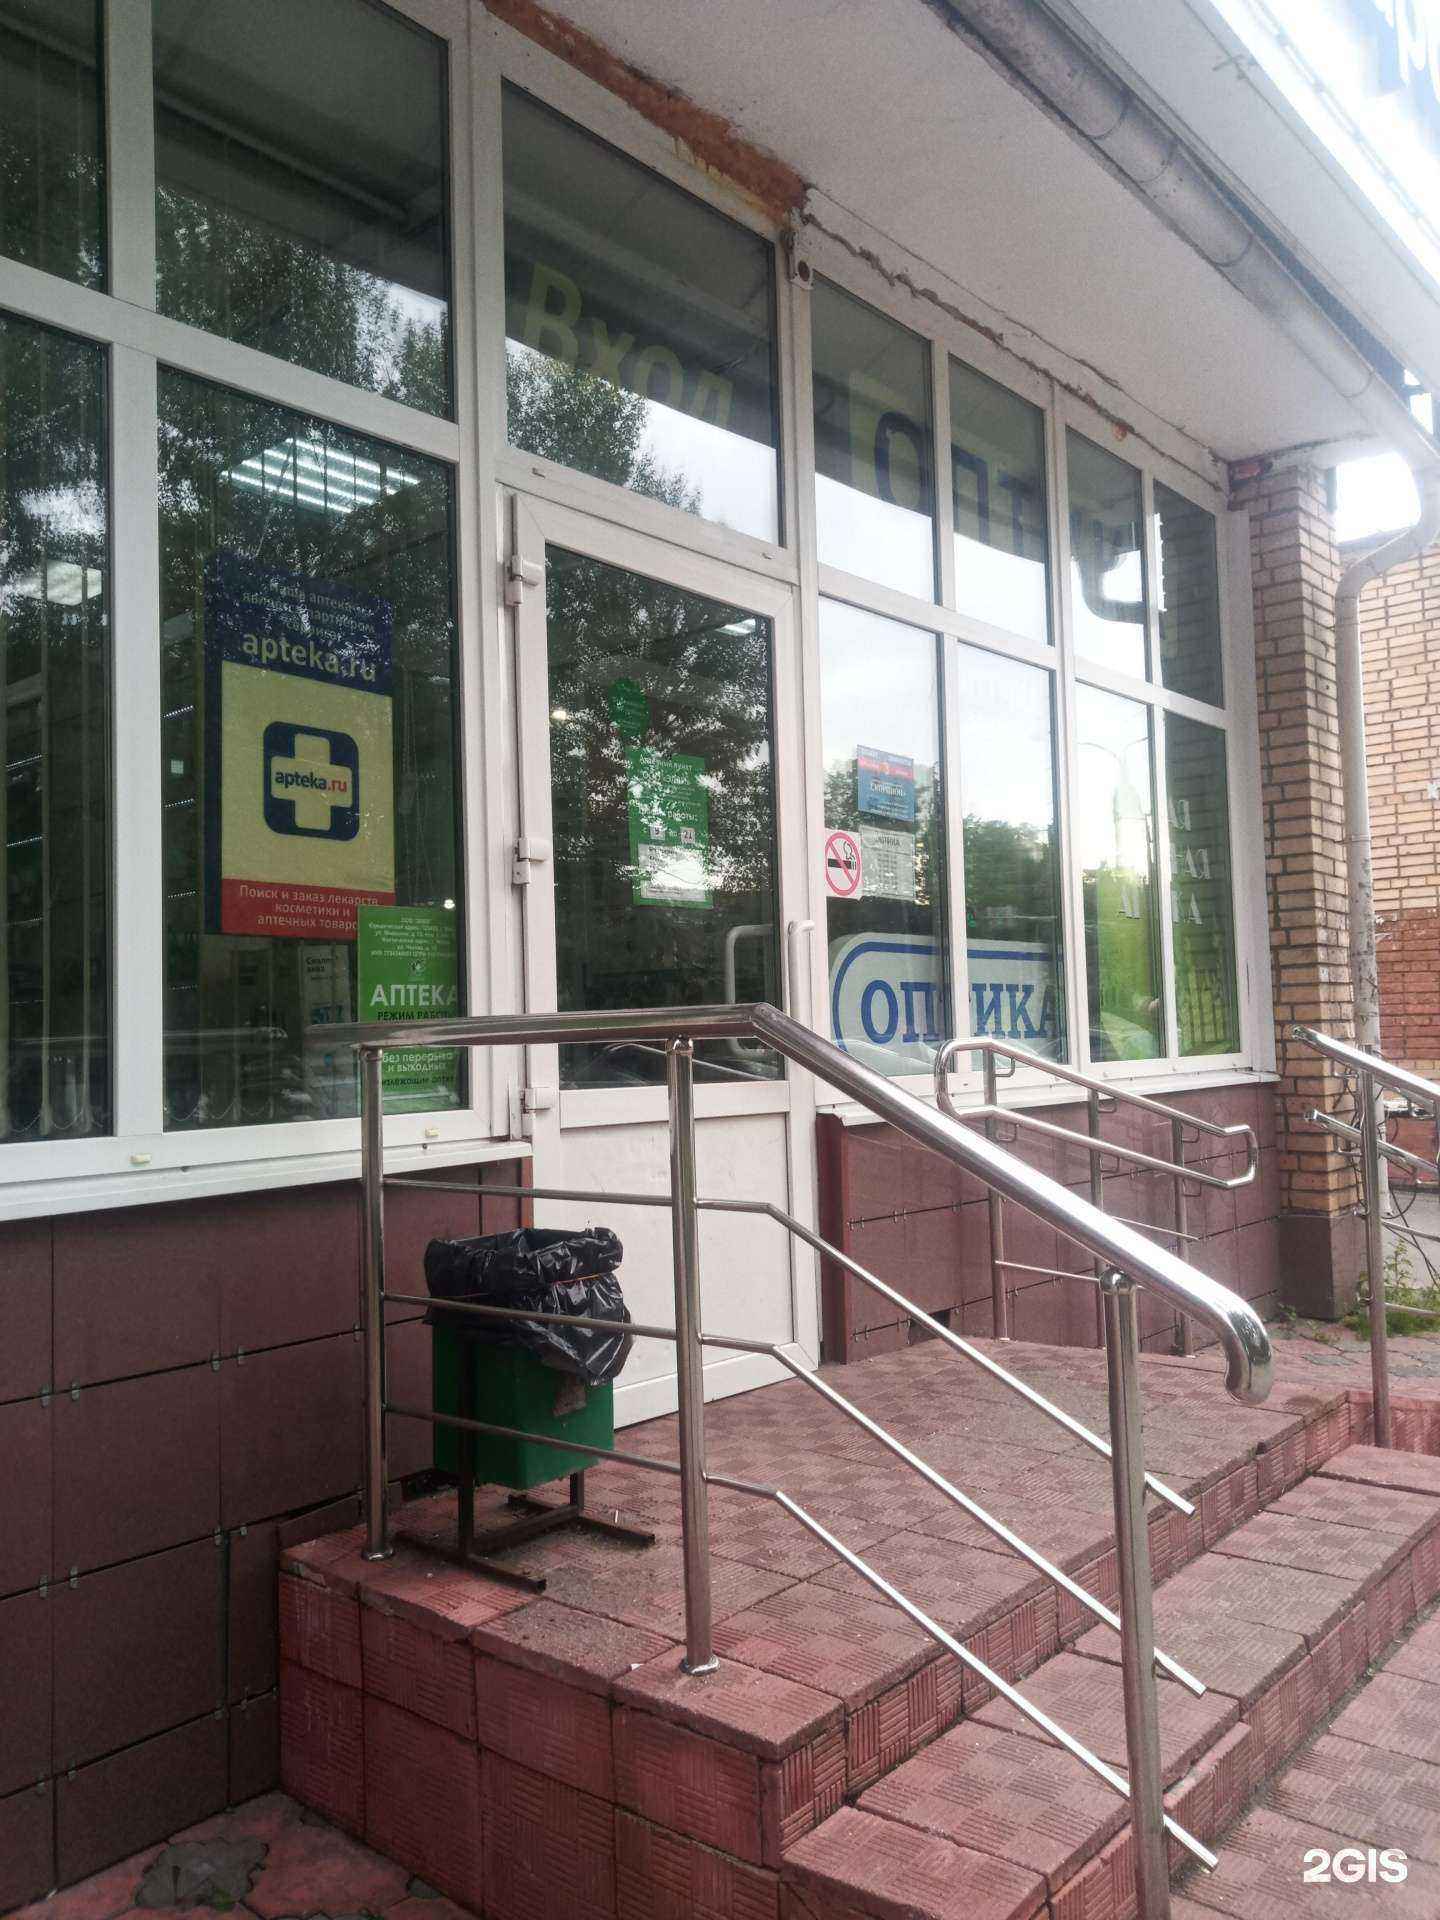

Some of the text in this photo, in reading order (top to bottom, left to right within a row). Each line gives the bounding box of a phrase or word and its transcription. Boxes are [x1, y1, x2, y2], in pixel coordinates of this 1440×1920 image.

[241, 631, 378, 684] apteka.ru
[274, 770, 348, 793] apteka.ru
[239, 884, 279, 900] Поиск
[282, 889, 290, 900] и
[293, 890, 325, 903] заказ
[275, 903, 351, 917] косметики и
[257, 914, 317, 929] аптечных
[369, 983, 458, 1007] АПТЕКА
[377, 1011, 416, 1021] РЕЖИМ
[861, 979, 1062, 1044] ОПИКА
